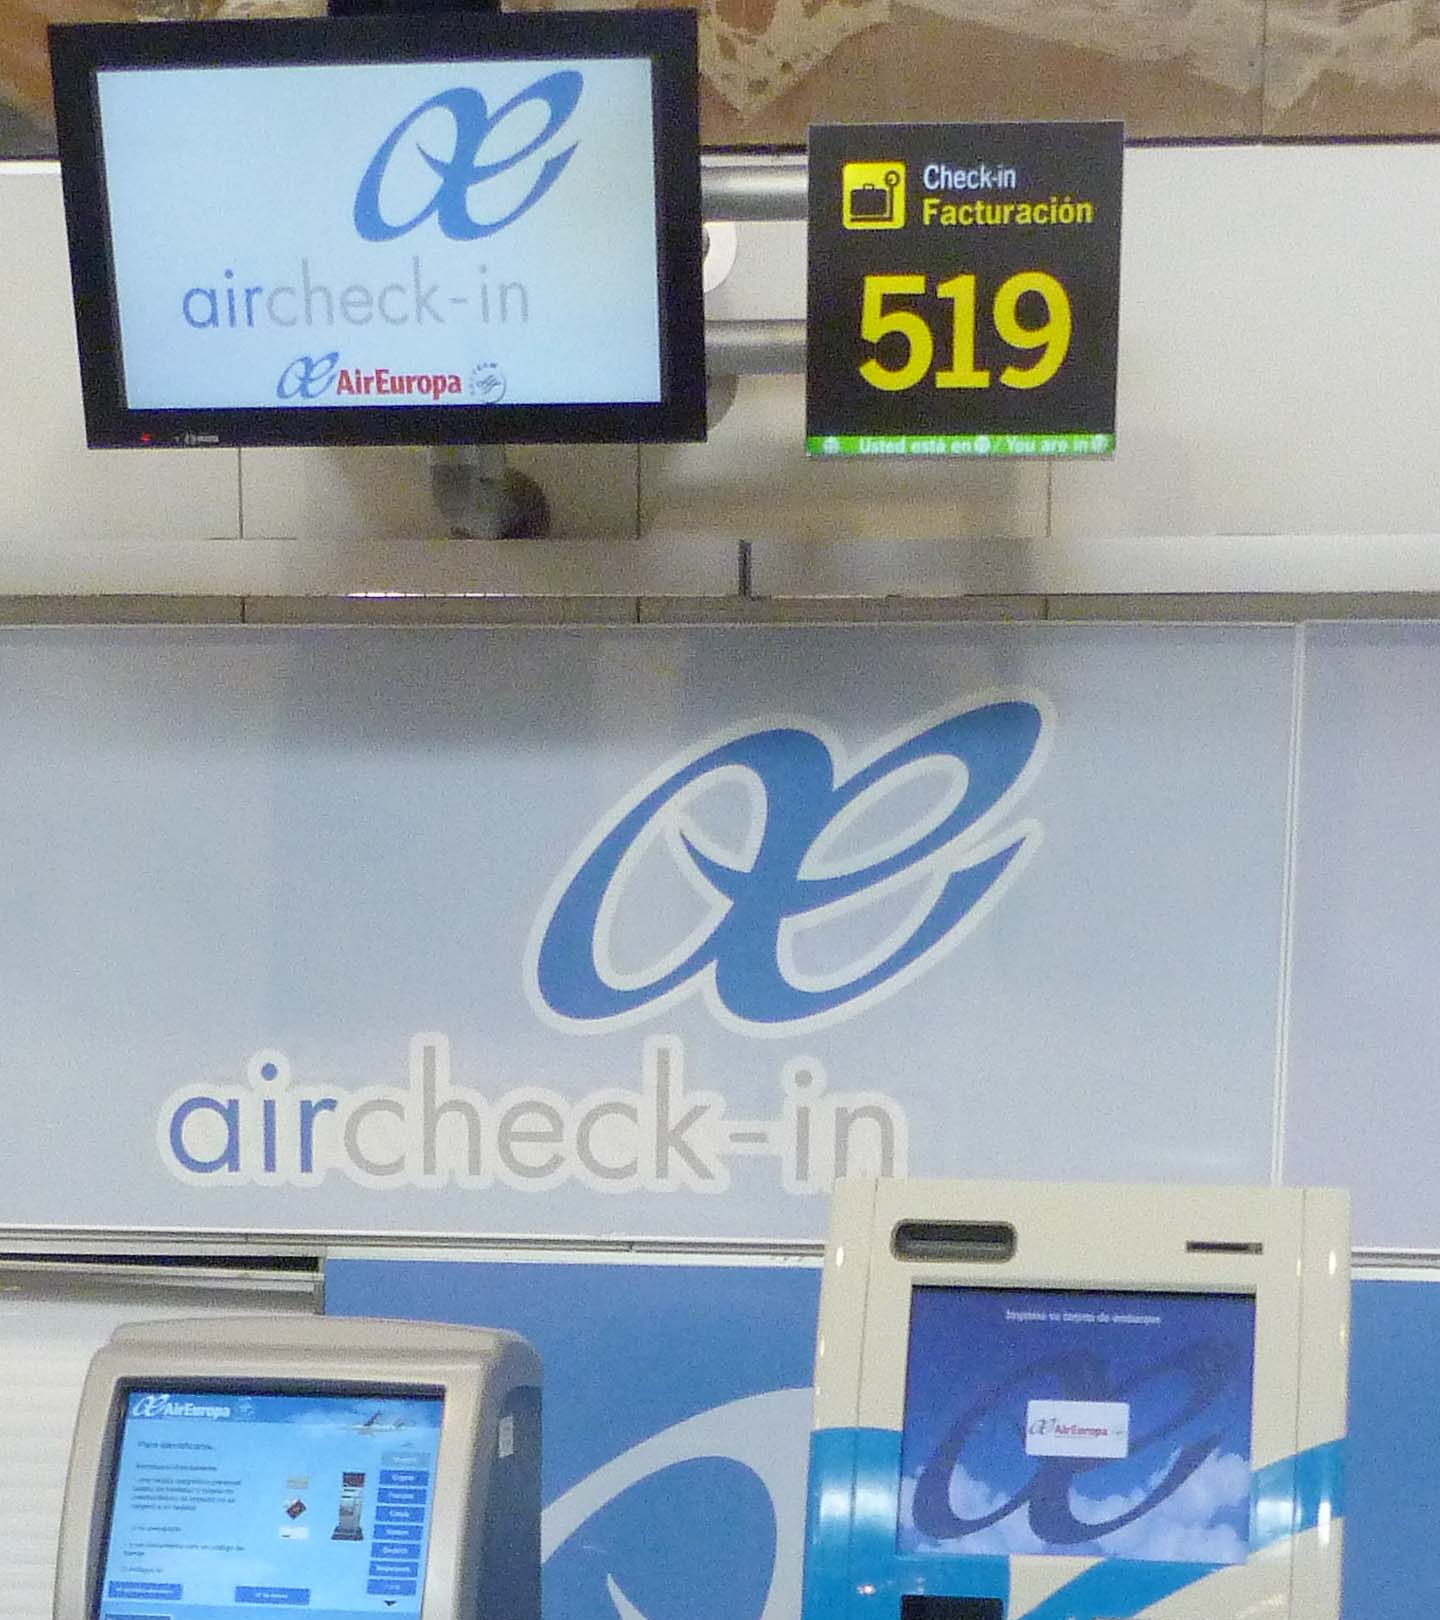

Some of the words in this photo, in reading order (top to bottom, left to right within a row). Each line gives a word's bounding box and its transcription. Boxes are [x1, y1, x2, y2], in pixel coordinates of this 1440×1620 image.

[924, 164, 1016, 189] Check-in
[922, 196, 1094, 224] Facturación
[183, 257, 529, 328] aircheck-in
[860, 271, 1072, 391] 519
[336, 367, 462, 400] AirEuropa
[169, 1042, 900, 1180] aircheck-in
[164, 1402, 231, 1421] AirEuropa
[1055, 1424, 1108, 1439] AirEuropa
